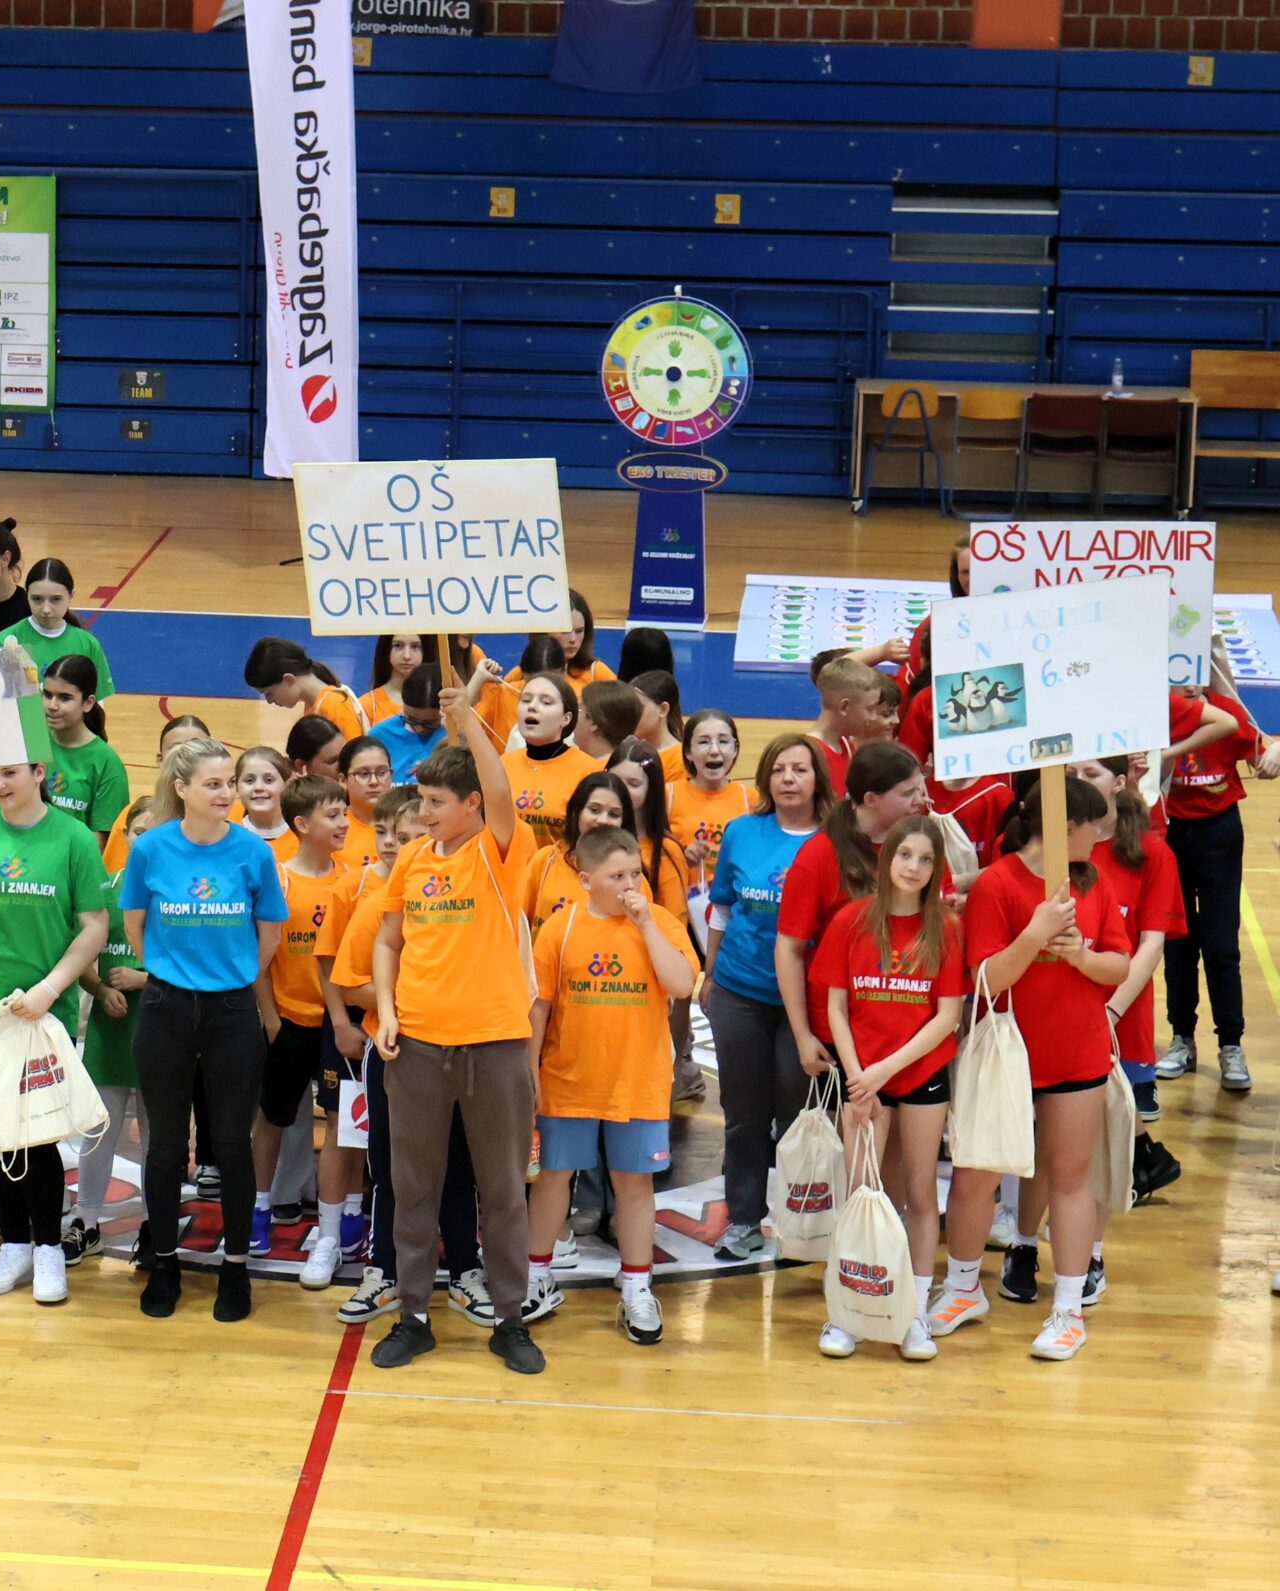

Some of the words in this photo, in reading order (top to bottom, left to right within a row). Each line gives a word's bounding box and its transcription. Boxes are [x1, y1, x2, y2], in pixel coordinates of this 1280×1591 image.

[4, 292, 19, 301] IPZ
[4, 386, 44, 394] AXIOM
[131, 387, 153, 398] TEAM
[627, 465, 655, 479] EKO
[655, 465, 717, 482] TWISTER
[386, 463, 454, 513] OŠ
[970, 524, 1027, 562] OŠ
[1036, 529, 1214, 562] VLADIMIR
[319, 574, 559, 617] OREHOVEC
[644, 587, 691, 596] KOMUNALNO
[51, 795, 88, 813] ZNANJEM
[7, 881, 56, 897] ZNANJEM
[742, 886, 769, 901] IGROM
[160, 900, 191, 916] IGROM
[199, 901, 246, 916] ZNANJEM
[405, 900, 422, 913] ROM
[429, 898, 475, 912] ZNANJEM
[287, 931, 317, 944] IGROM
[599, 981, 648, 995] ZNANJEM
